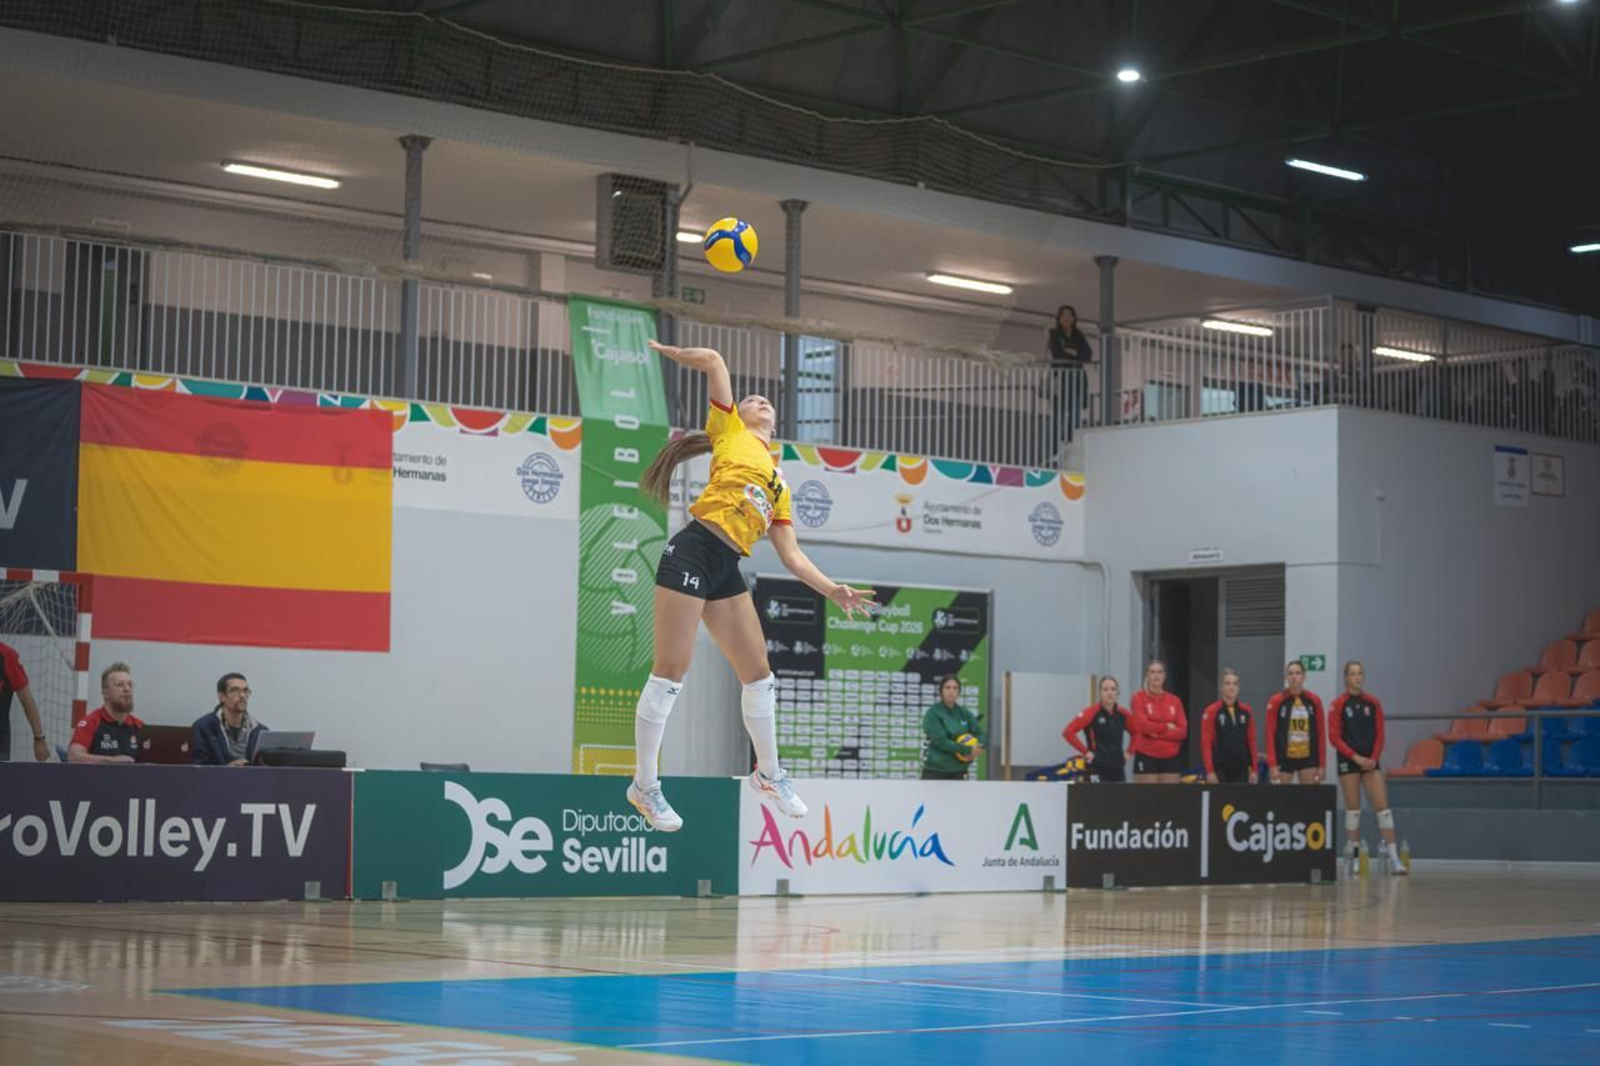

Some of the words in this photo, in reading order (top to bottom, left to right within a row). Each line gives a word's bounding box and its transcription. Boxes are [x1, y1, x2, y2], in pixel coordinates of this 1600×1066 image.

[434, 456, 447, 466] de
[393, 467, 447, 482] Hermanas
[609, 387, 641, 615] VOLEIBOL
[923, 514, 940, 525] Dos
[682, 571, 700, 590] 14
[879, 619, 899, 635] Cup
[750, 802, 956, 869] Andalucía
[1070, 821, 1189, 850] Fundación
[1222, 804, 1333, 863] Cajasol
[562, 836, 668, 873] Sevilla
[981, 856, 1006, 867] Junta
[1008, 857, 1018, 867] de
[1019, 855, 1060, 867] Andalucía
